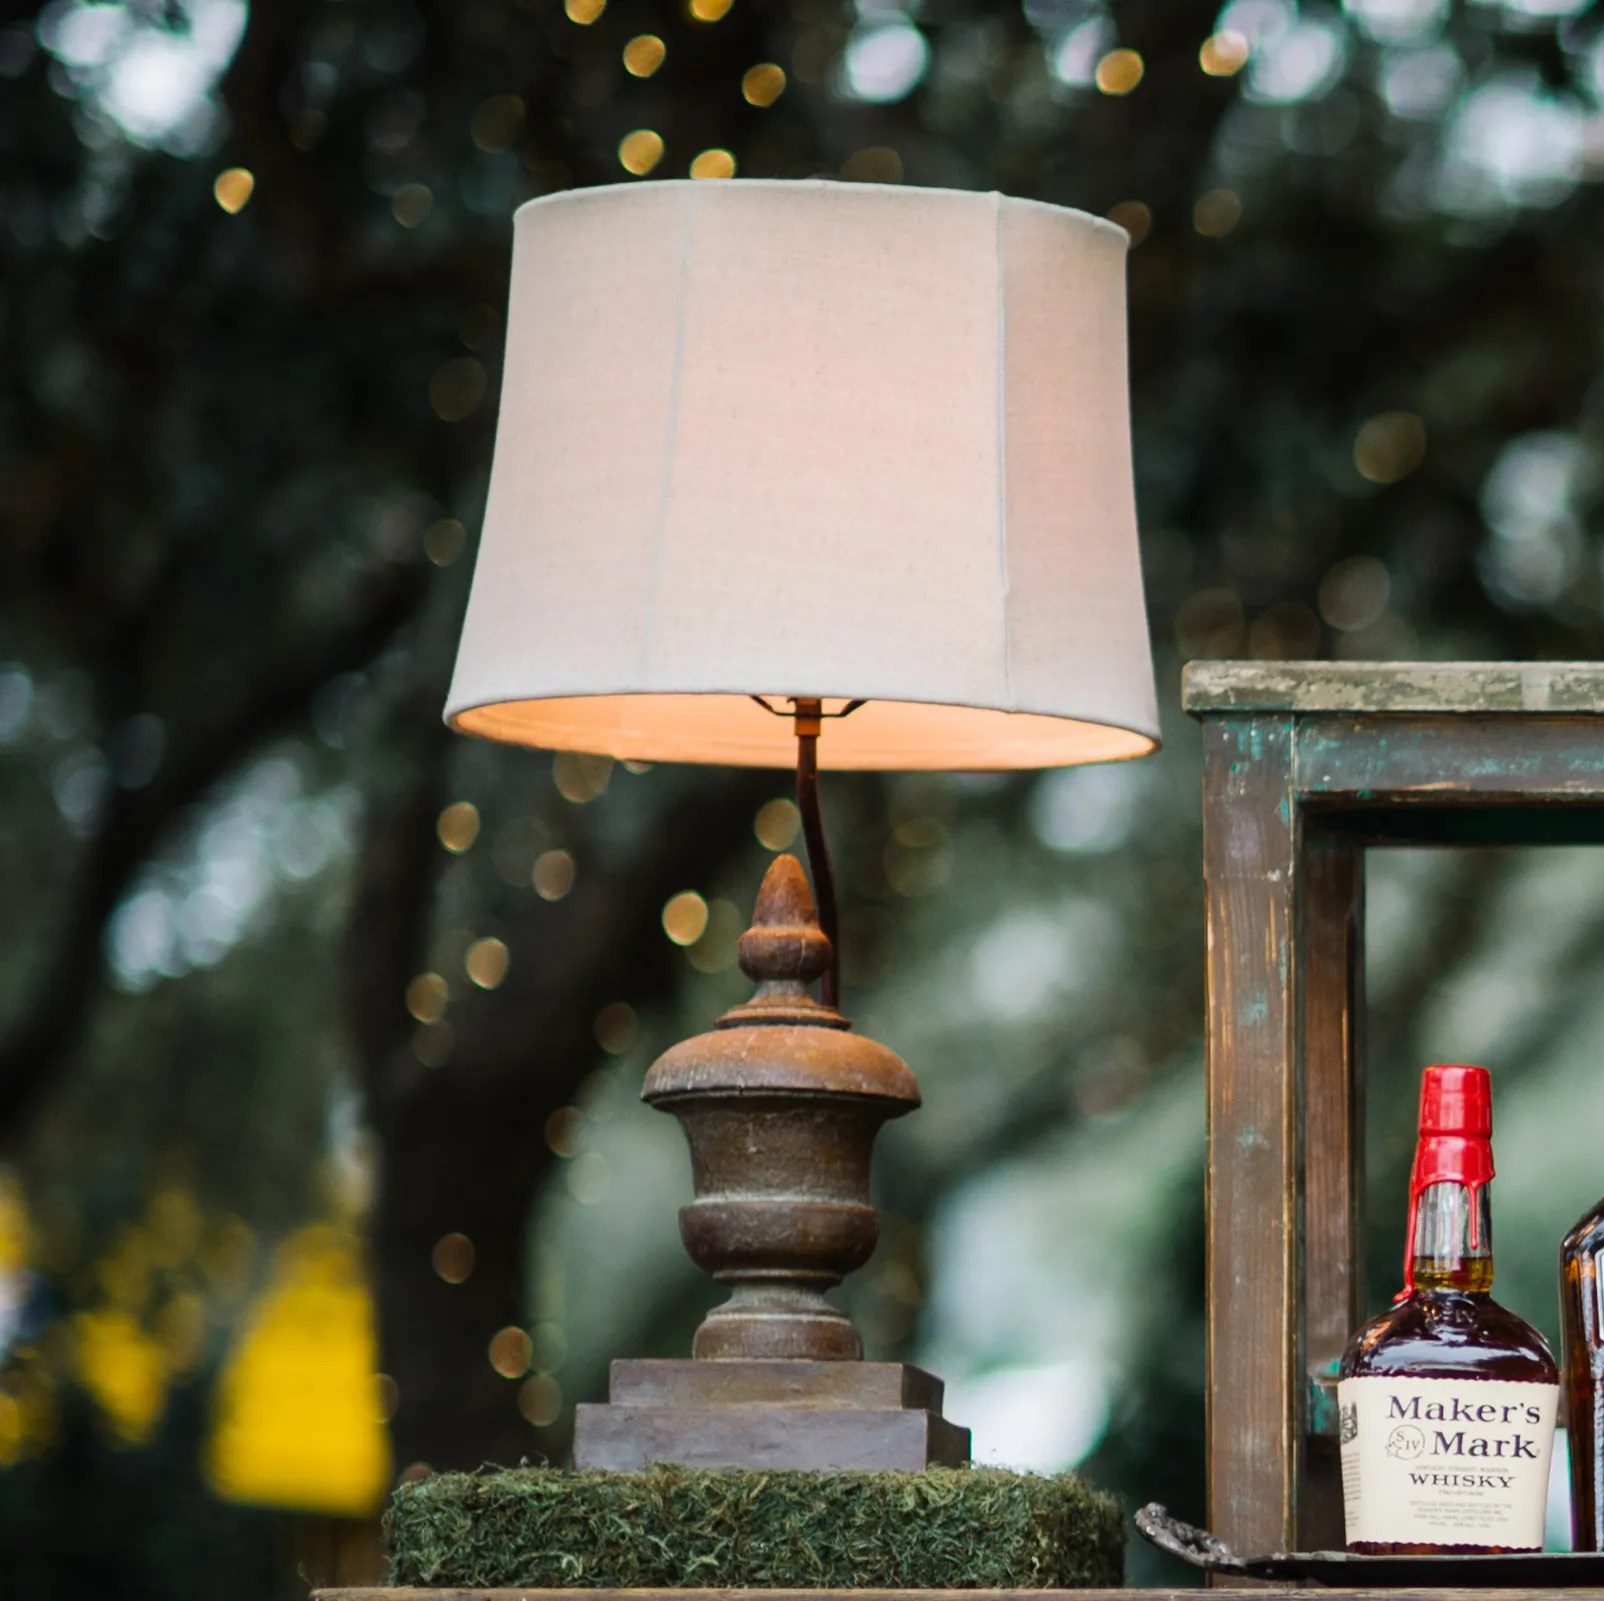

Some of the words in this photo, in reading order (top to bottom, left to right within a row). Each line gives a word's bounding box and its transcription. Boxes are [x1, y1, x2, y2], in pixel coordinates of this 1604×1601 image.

[1386, 1395, 1541, 1424] Maker's
[1396, 1431, 1405, 1442] S
[1430, 1430, 1538, 1458] Mark
[1408, 1473, 1516, 1489] WHISKY
